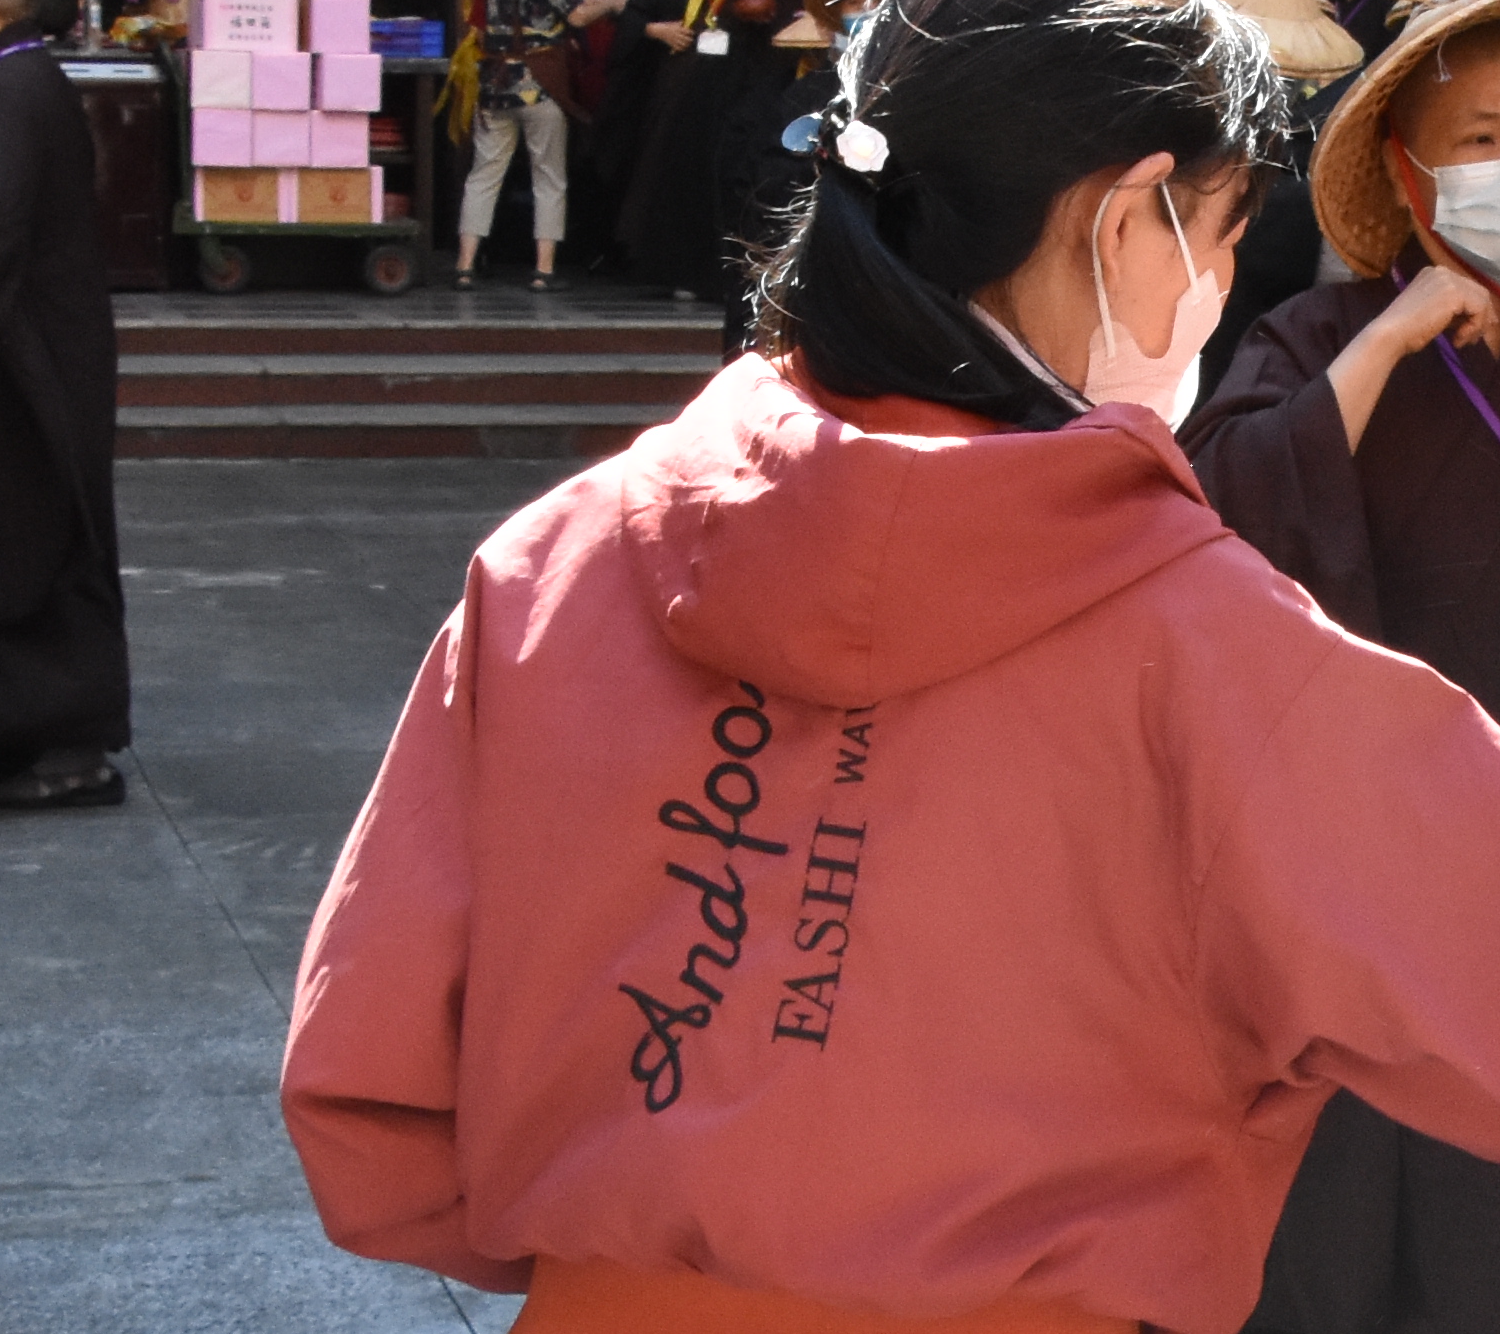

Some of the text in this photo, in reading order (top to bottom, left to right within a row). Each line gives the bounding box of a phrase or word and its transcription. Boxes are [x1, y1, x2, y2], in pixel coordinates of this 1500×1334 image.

[618, 679, 788, 1116] And foo
[771, 815, 868, 1053] FASHI
